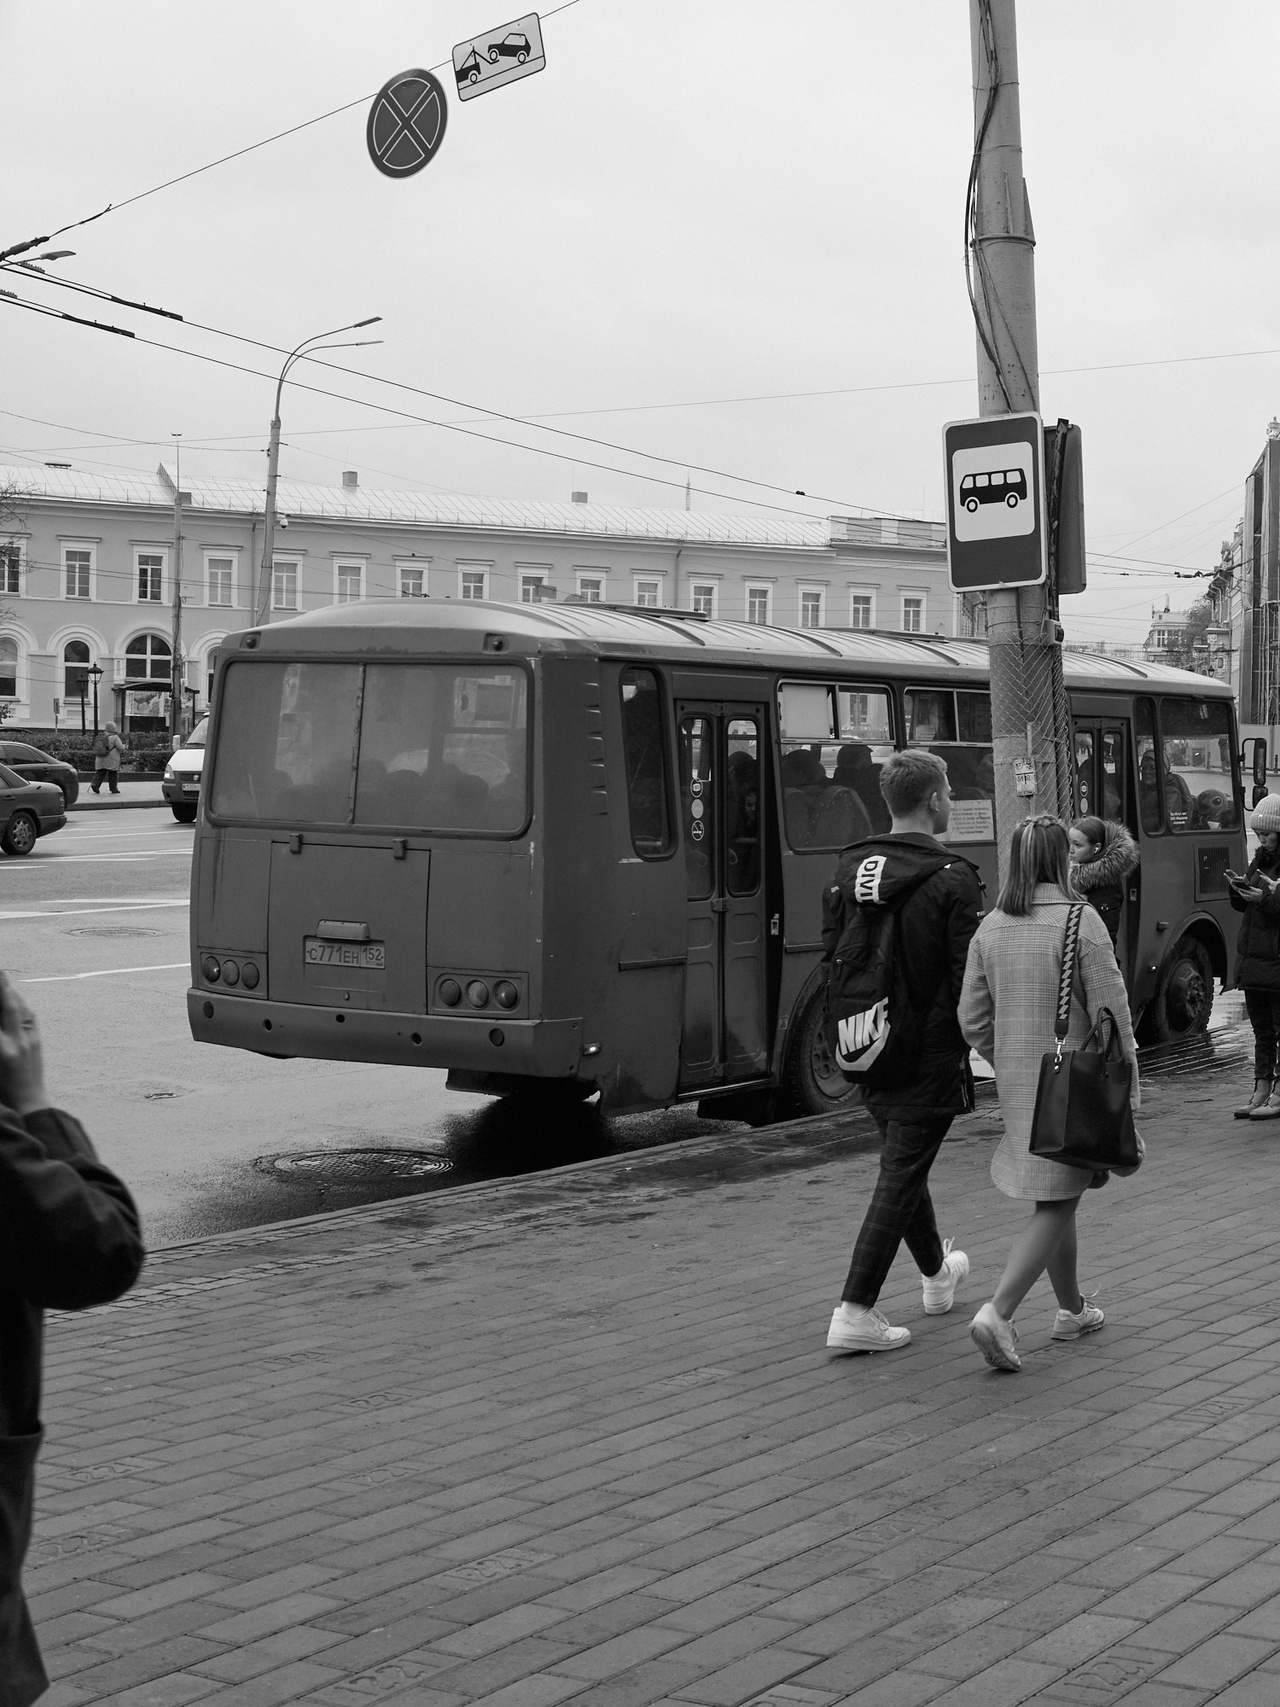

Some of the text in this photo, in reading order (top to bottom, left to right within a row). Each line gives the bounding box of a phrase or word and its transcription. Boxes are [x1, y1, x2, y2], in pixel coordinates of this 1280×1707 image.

[362, 947, 382, 961] 152
[838, 996, 889, 1056] NIKE
[1183, 1400, 1245, 1419] 1221
[58, 1461, 142, 1484] 1221
[445, 1553, 536, 1582] 1221
[333, 1659, 441, 1696] 1221
[1063, 1655, 1154, 1693] 1221
